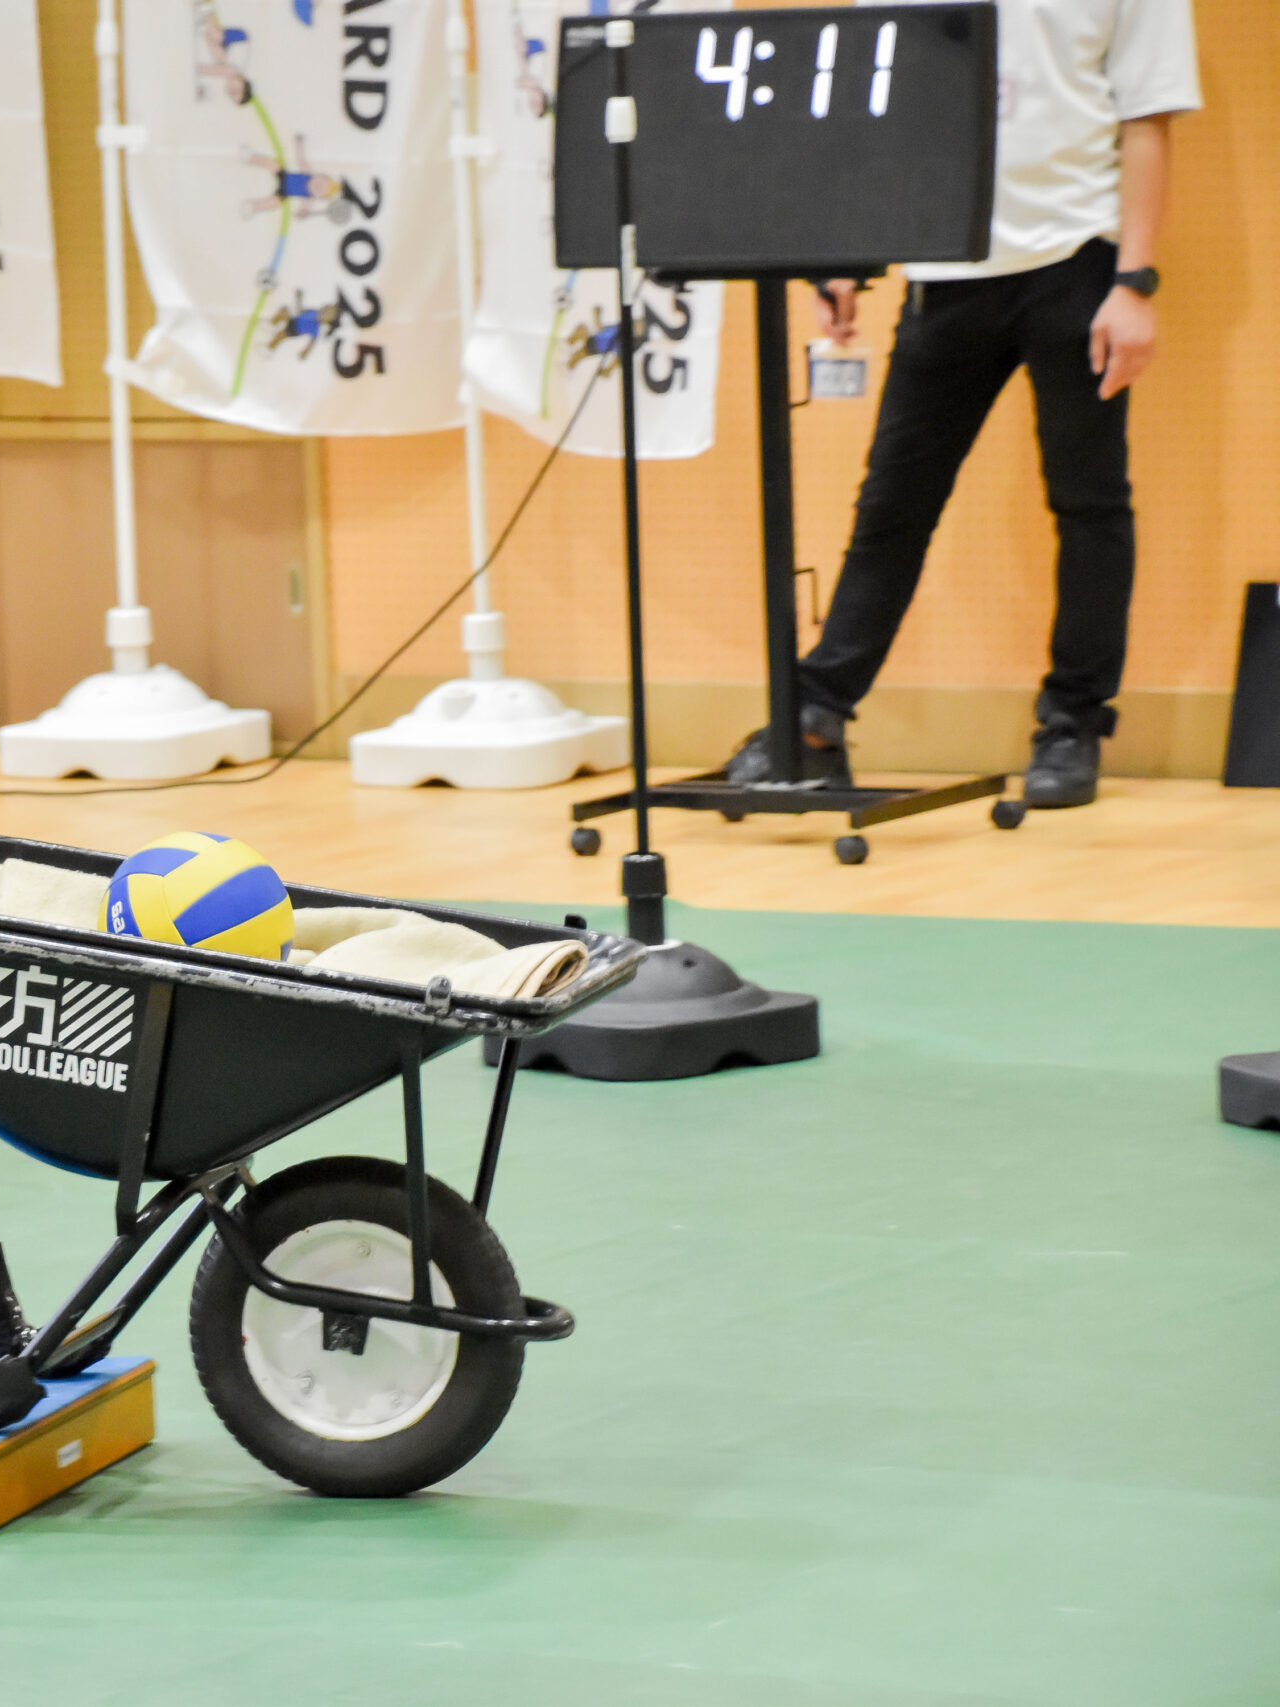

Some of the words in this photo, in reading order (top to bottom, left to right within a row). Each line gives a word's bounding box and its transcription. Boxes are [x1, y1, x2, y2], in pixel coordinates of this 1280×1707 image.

[696, 22, 897, 121] 4:11
[333, 174, 385, 379] 2025
[643, 288, 691, 394] 25
